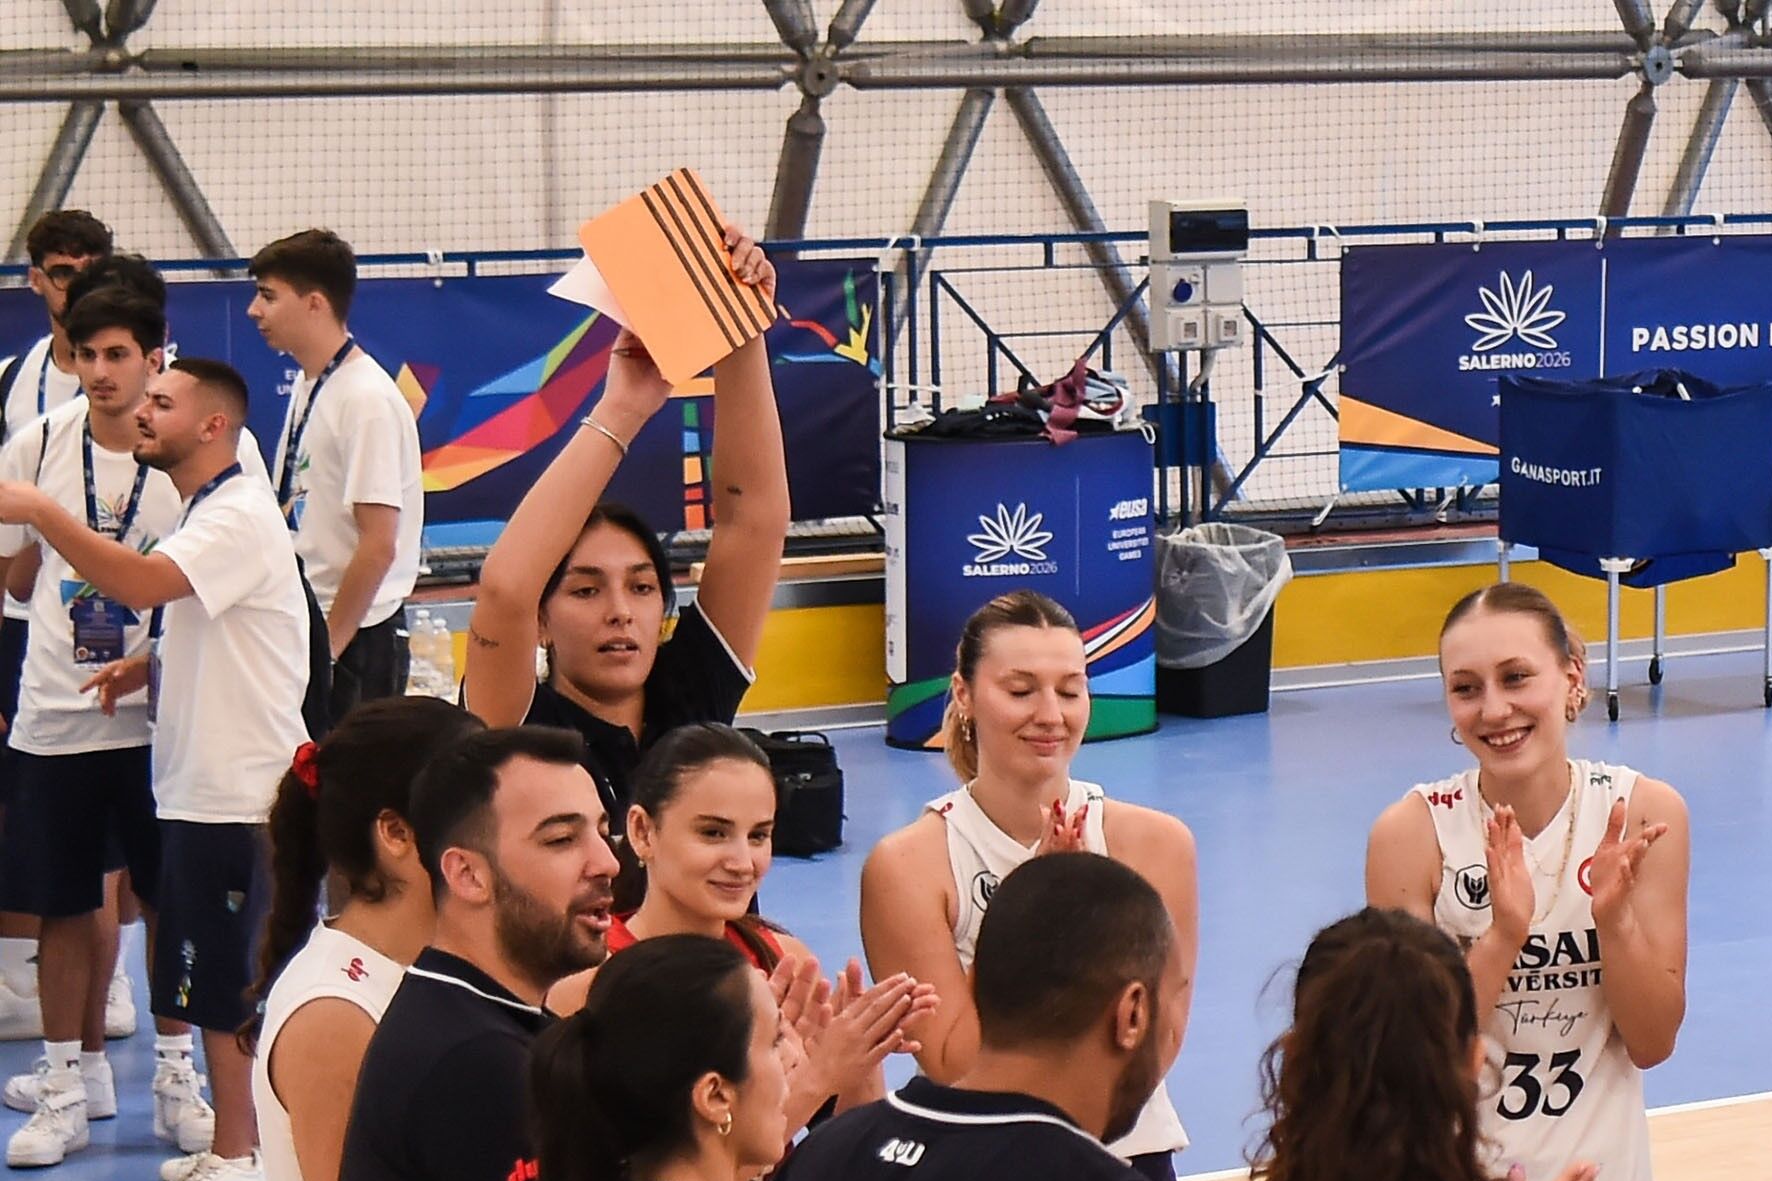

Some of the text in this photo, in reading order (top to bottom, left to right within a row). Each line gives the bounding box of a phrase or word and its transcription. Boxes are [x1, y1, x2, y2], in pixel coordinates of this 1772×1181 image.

[1632, 323, 1759, 352] PASSION
[1511, 457, 1602, 487] GANASPORT.IT
[1496, 1049, 1584, 1121] 33
